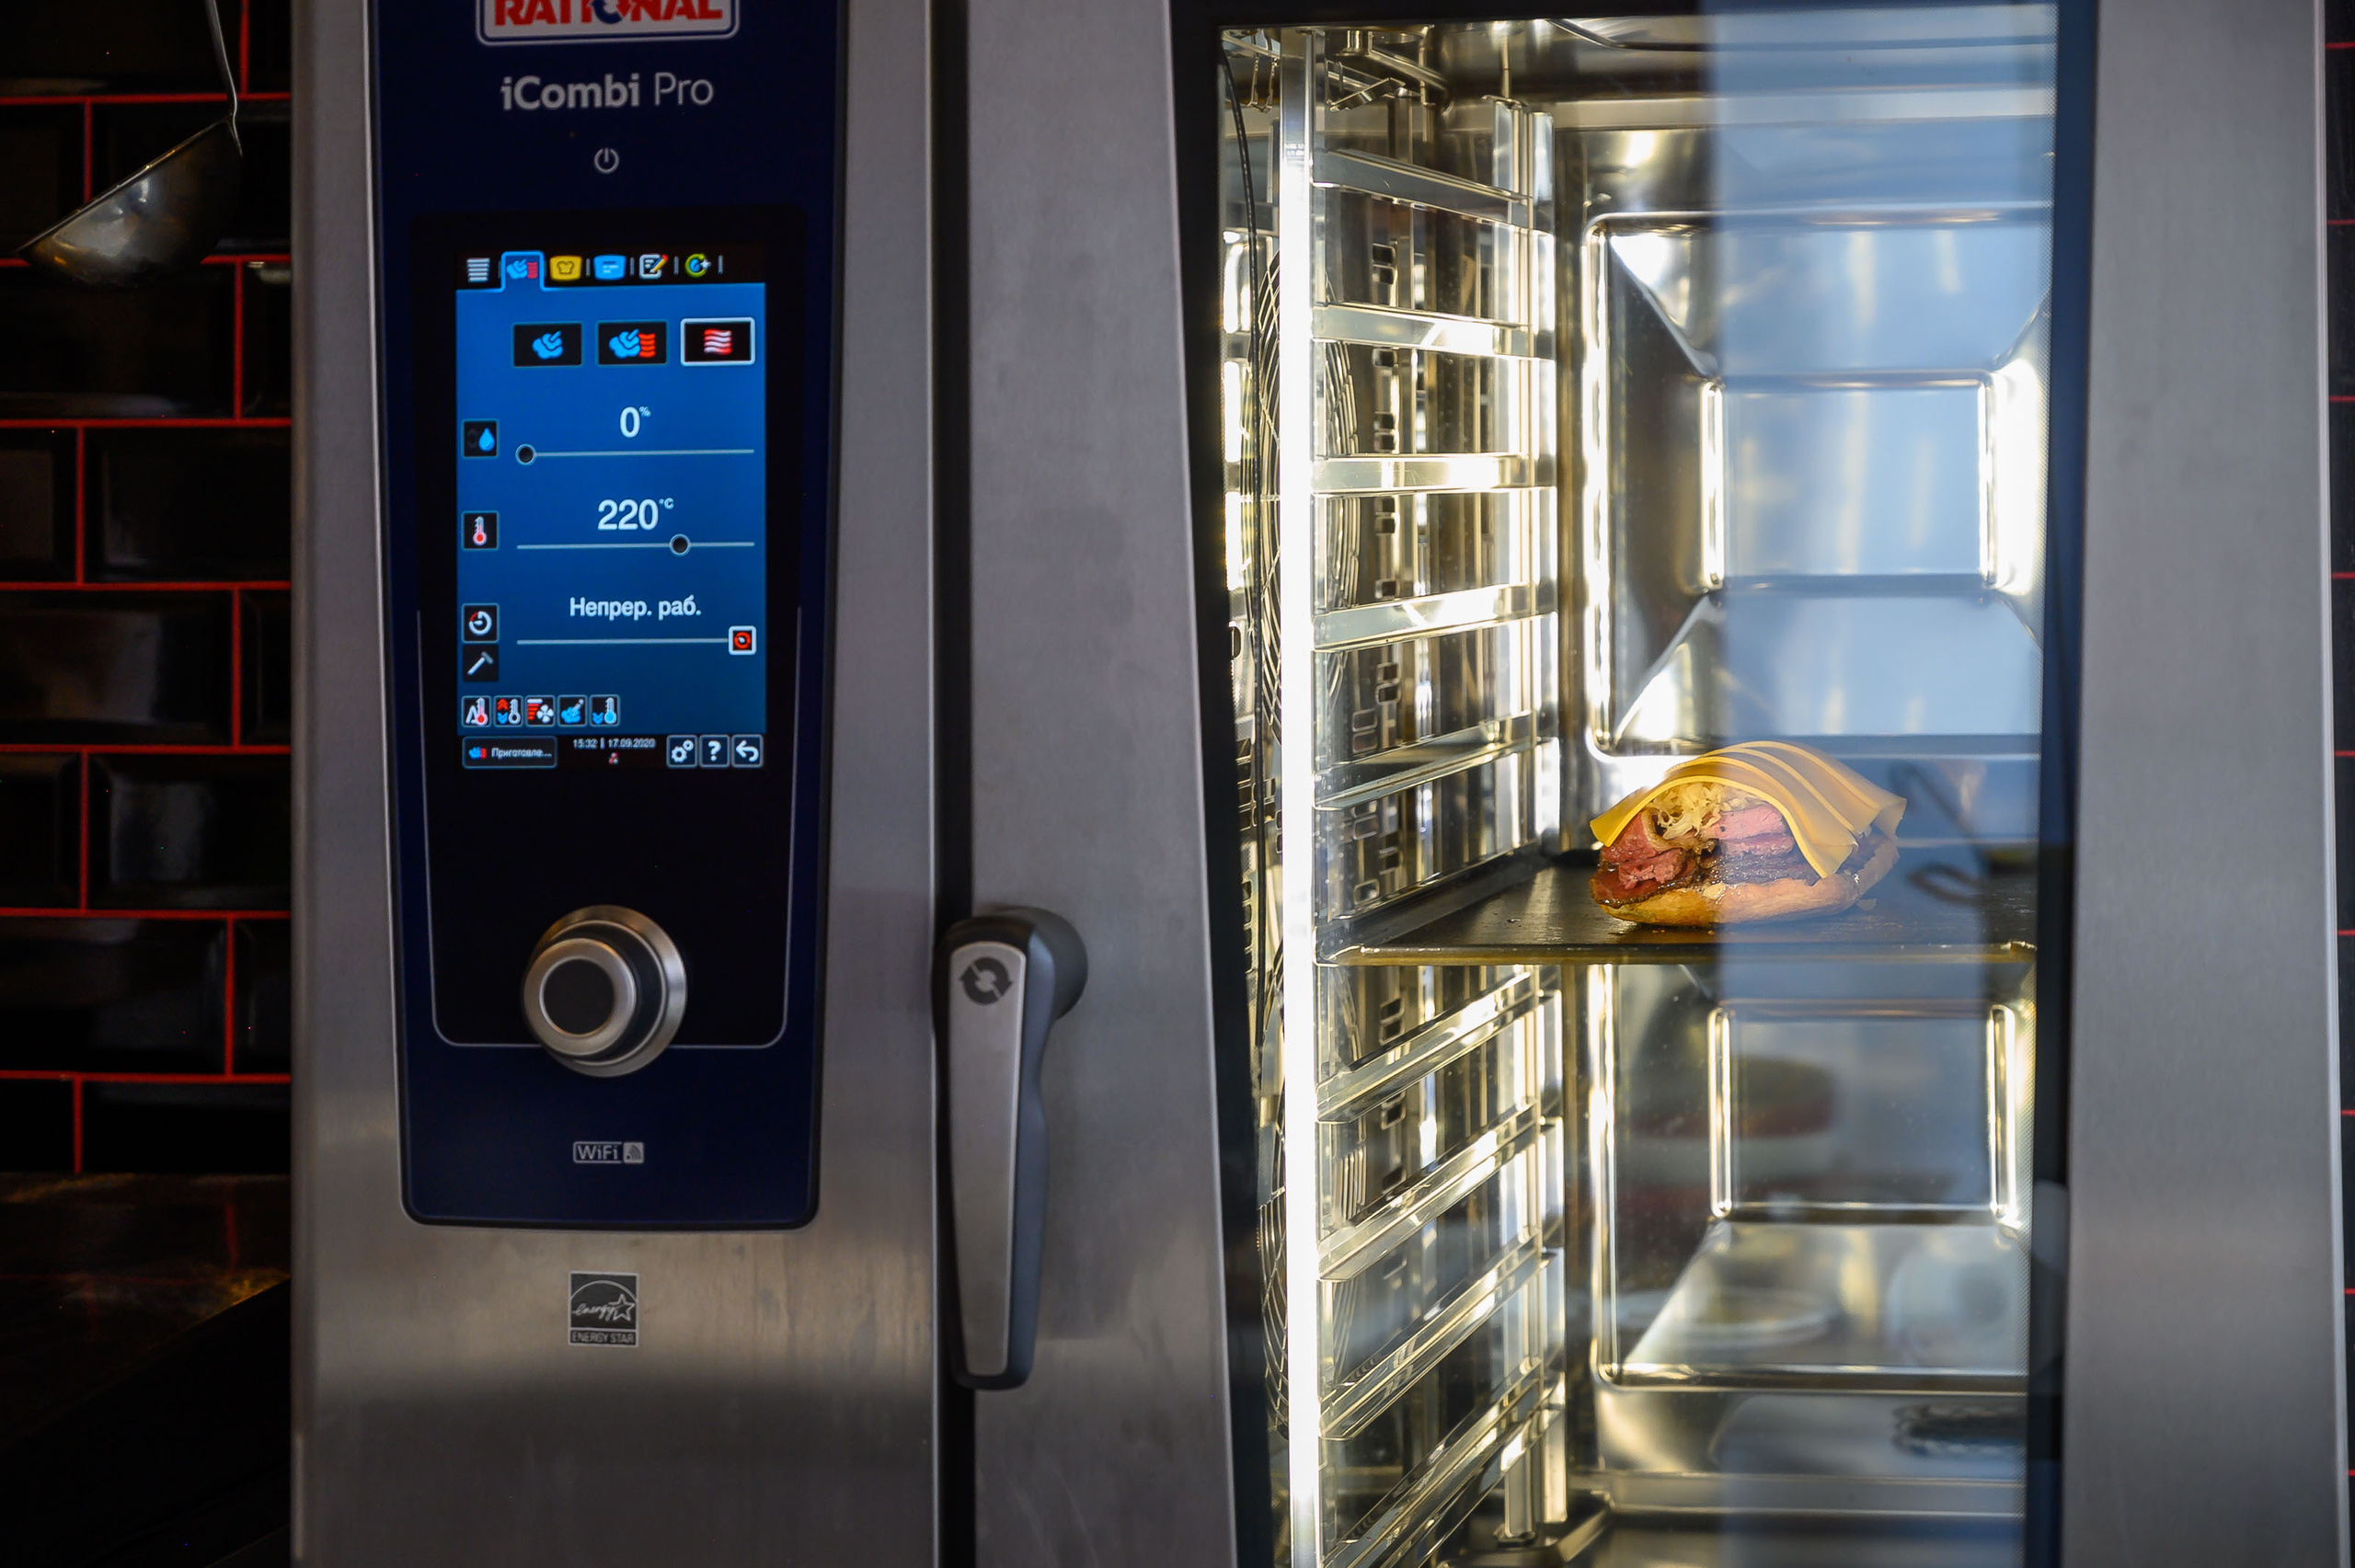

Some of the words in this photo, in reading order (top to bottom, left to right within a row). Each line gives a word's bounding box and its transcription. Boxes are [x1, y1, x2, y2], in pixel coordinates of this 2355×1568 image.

[500, 73, 640, 110] iCombi
[654, 72, 714, 106] Pro
[569, 597, 652, 622] Непрер.
[658, 594, 702, 622] раб.
[572, 738, 598, 750] 15:32
[607, 738, 656, 750] 17.09.2020
[577, 1144, 618, 1161] WiFi
[571, 1331, 608, 1343] ENERGY
[610, 1333, 635, 1344] STAR
